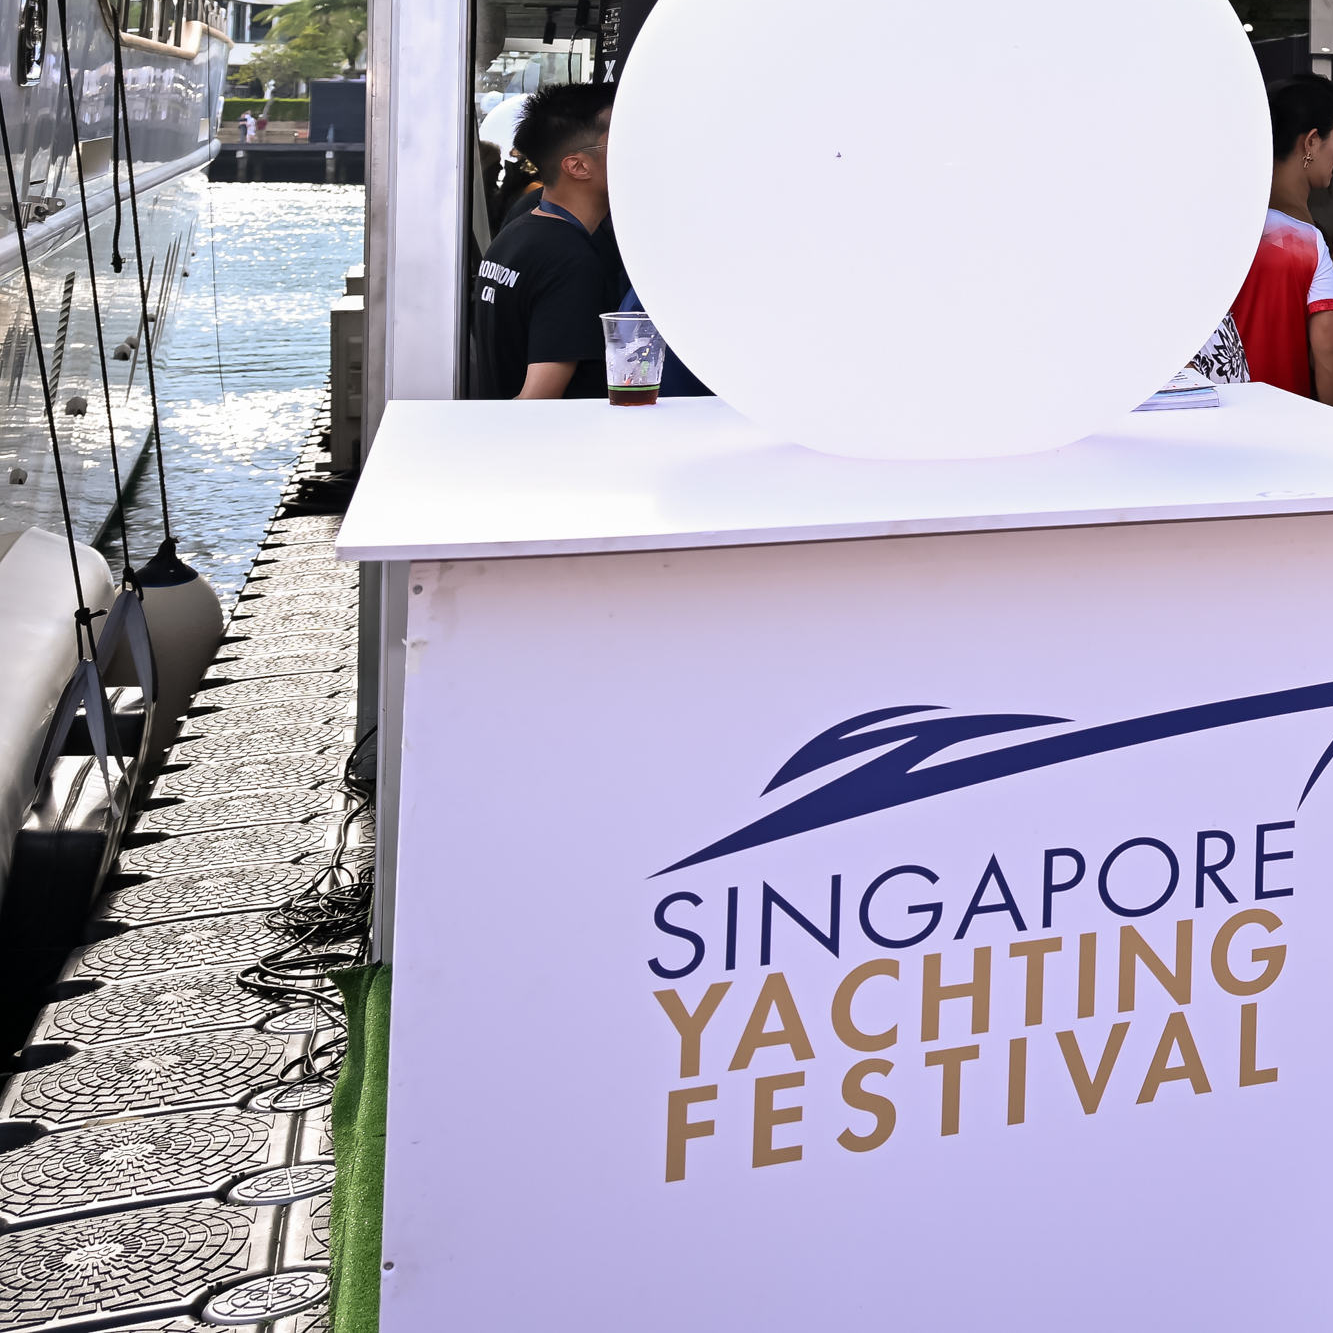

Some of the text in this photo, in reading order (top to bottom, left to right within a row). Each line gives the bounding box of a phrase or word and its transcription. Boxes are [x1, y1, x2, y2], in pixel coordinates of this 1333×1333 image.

[647, 820, 1296, 980] SINGAPORE
[653, 908, 1287, 1078] YACHTING
[665, 1002, 1278, 1183] FESTIVAL
